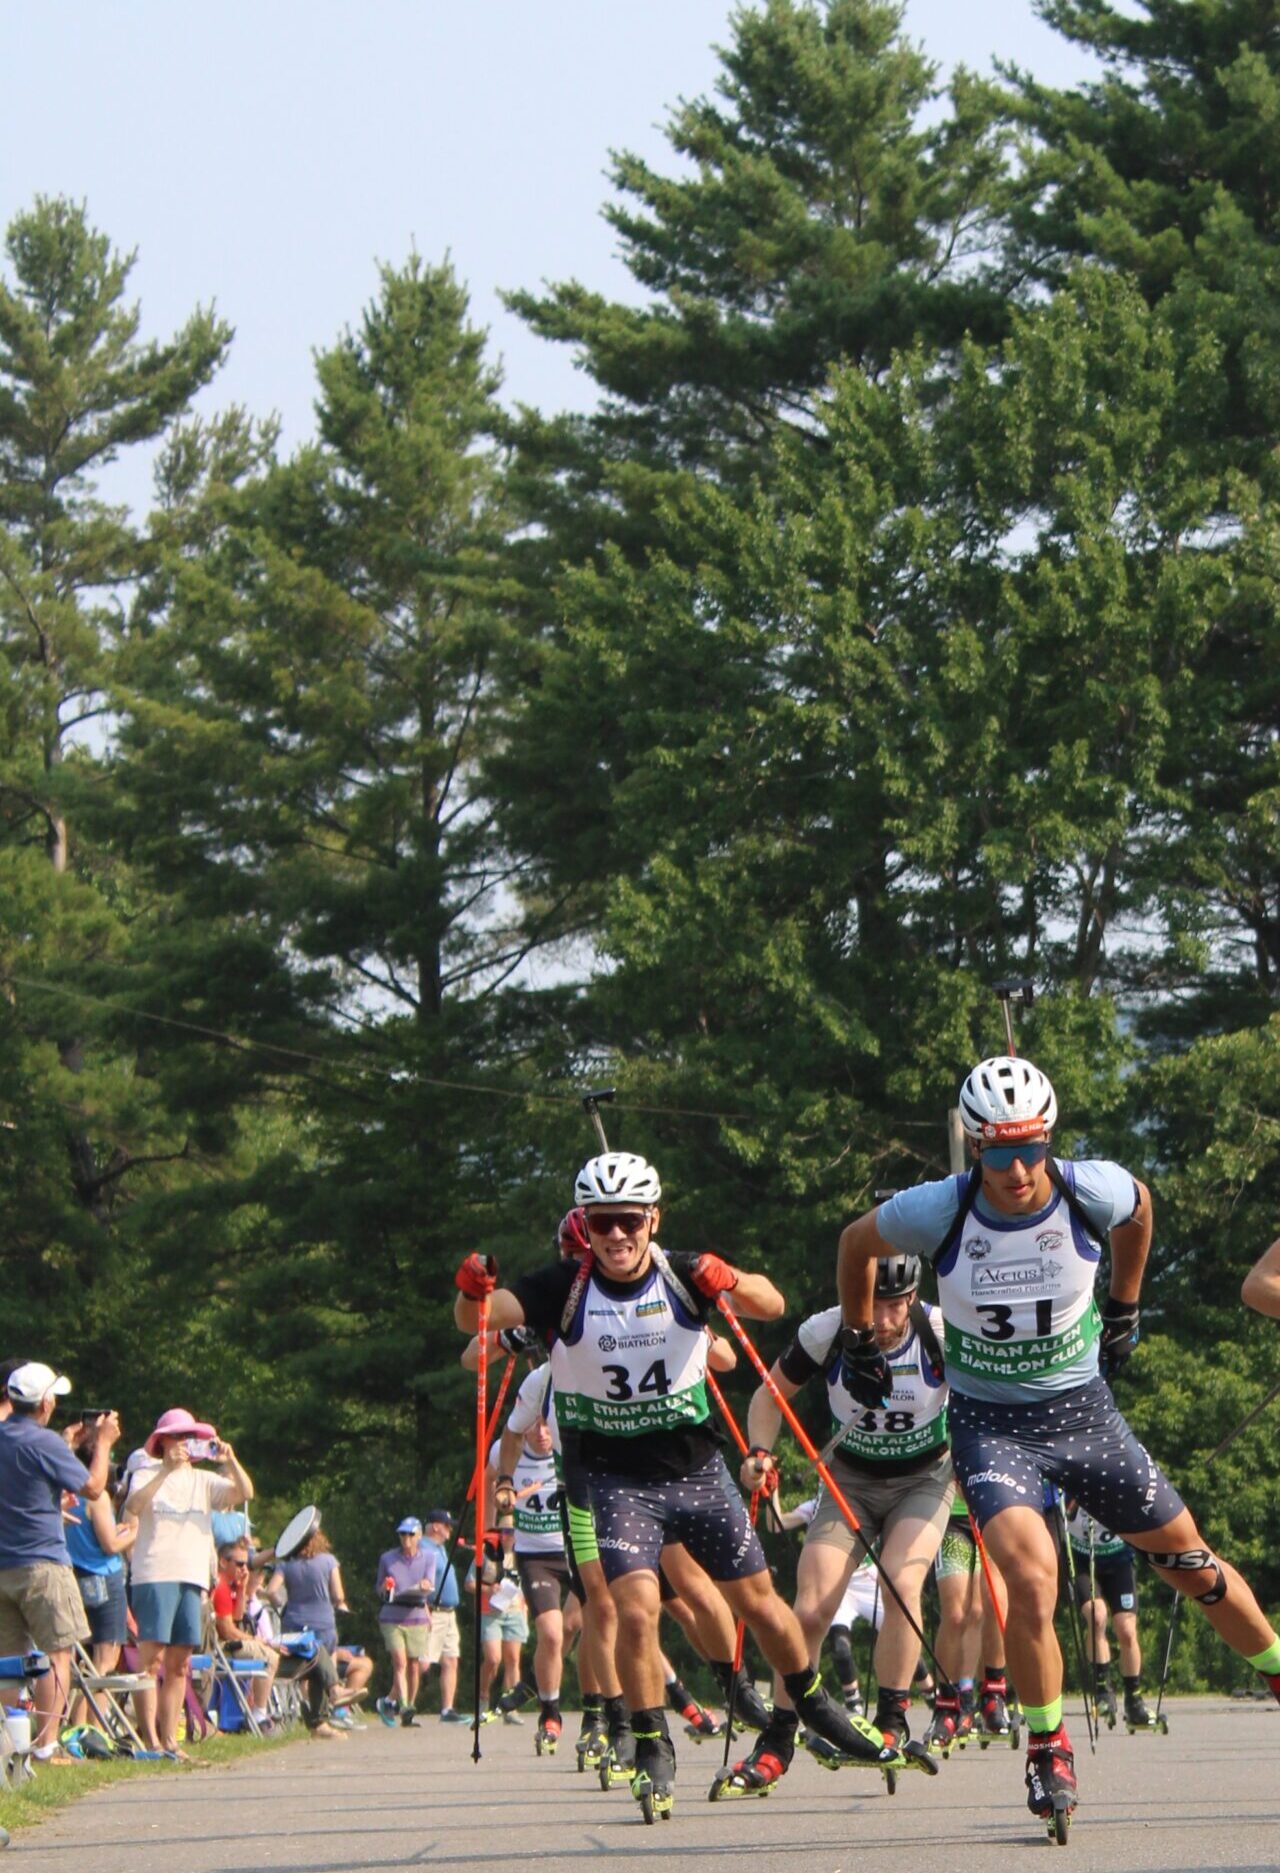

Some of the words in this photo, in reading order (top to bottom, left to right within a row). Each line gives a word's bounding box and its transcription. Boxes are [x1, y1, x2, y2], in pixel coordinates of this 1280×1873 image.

[976, 1299, 1053, 1341] 31
[618, 1335, 666, 1349] BIATHLON
[961, 1336, 1023, 1358] ETHAN
[1029, 1324, 1081, 1354] ALLEN
[960, 1352, 1045, 1375] BIATHLON
[1051, 1340, 1085, 1365] CLUB
[602, 1359, 671, 1401] 34
[593, 1402, 642, 1417] ETHAN
[594, 1414, 662, 1431] BIATHLON
[851, 1411, 914, 1432] 38
[846, 1428, 884, 1445] THAN
[967, 1469, 1017, 1488] maloja
[597, 1535, 630, 1551] aloja
